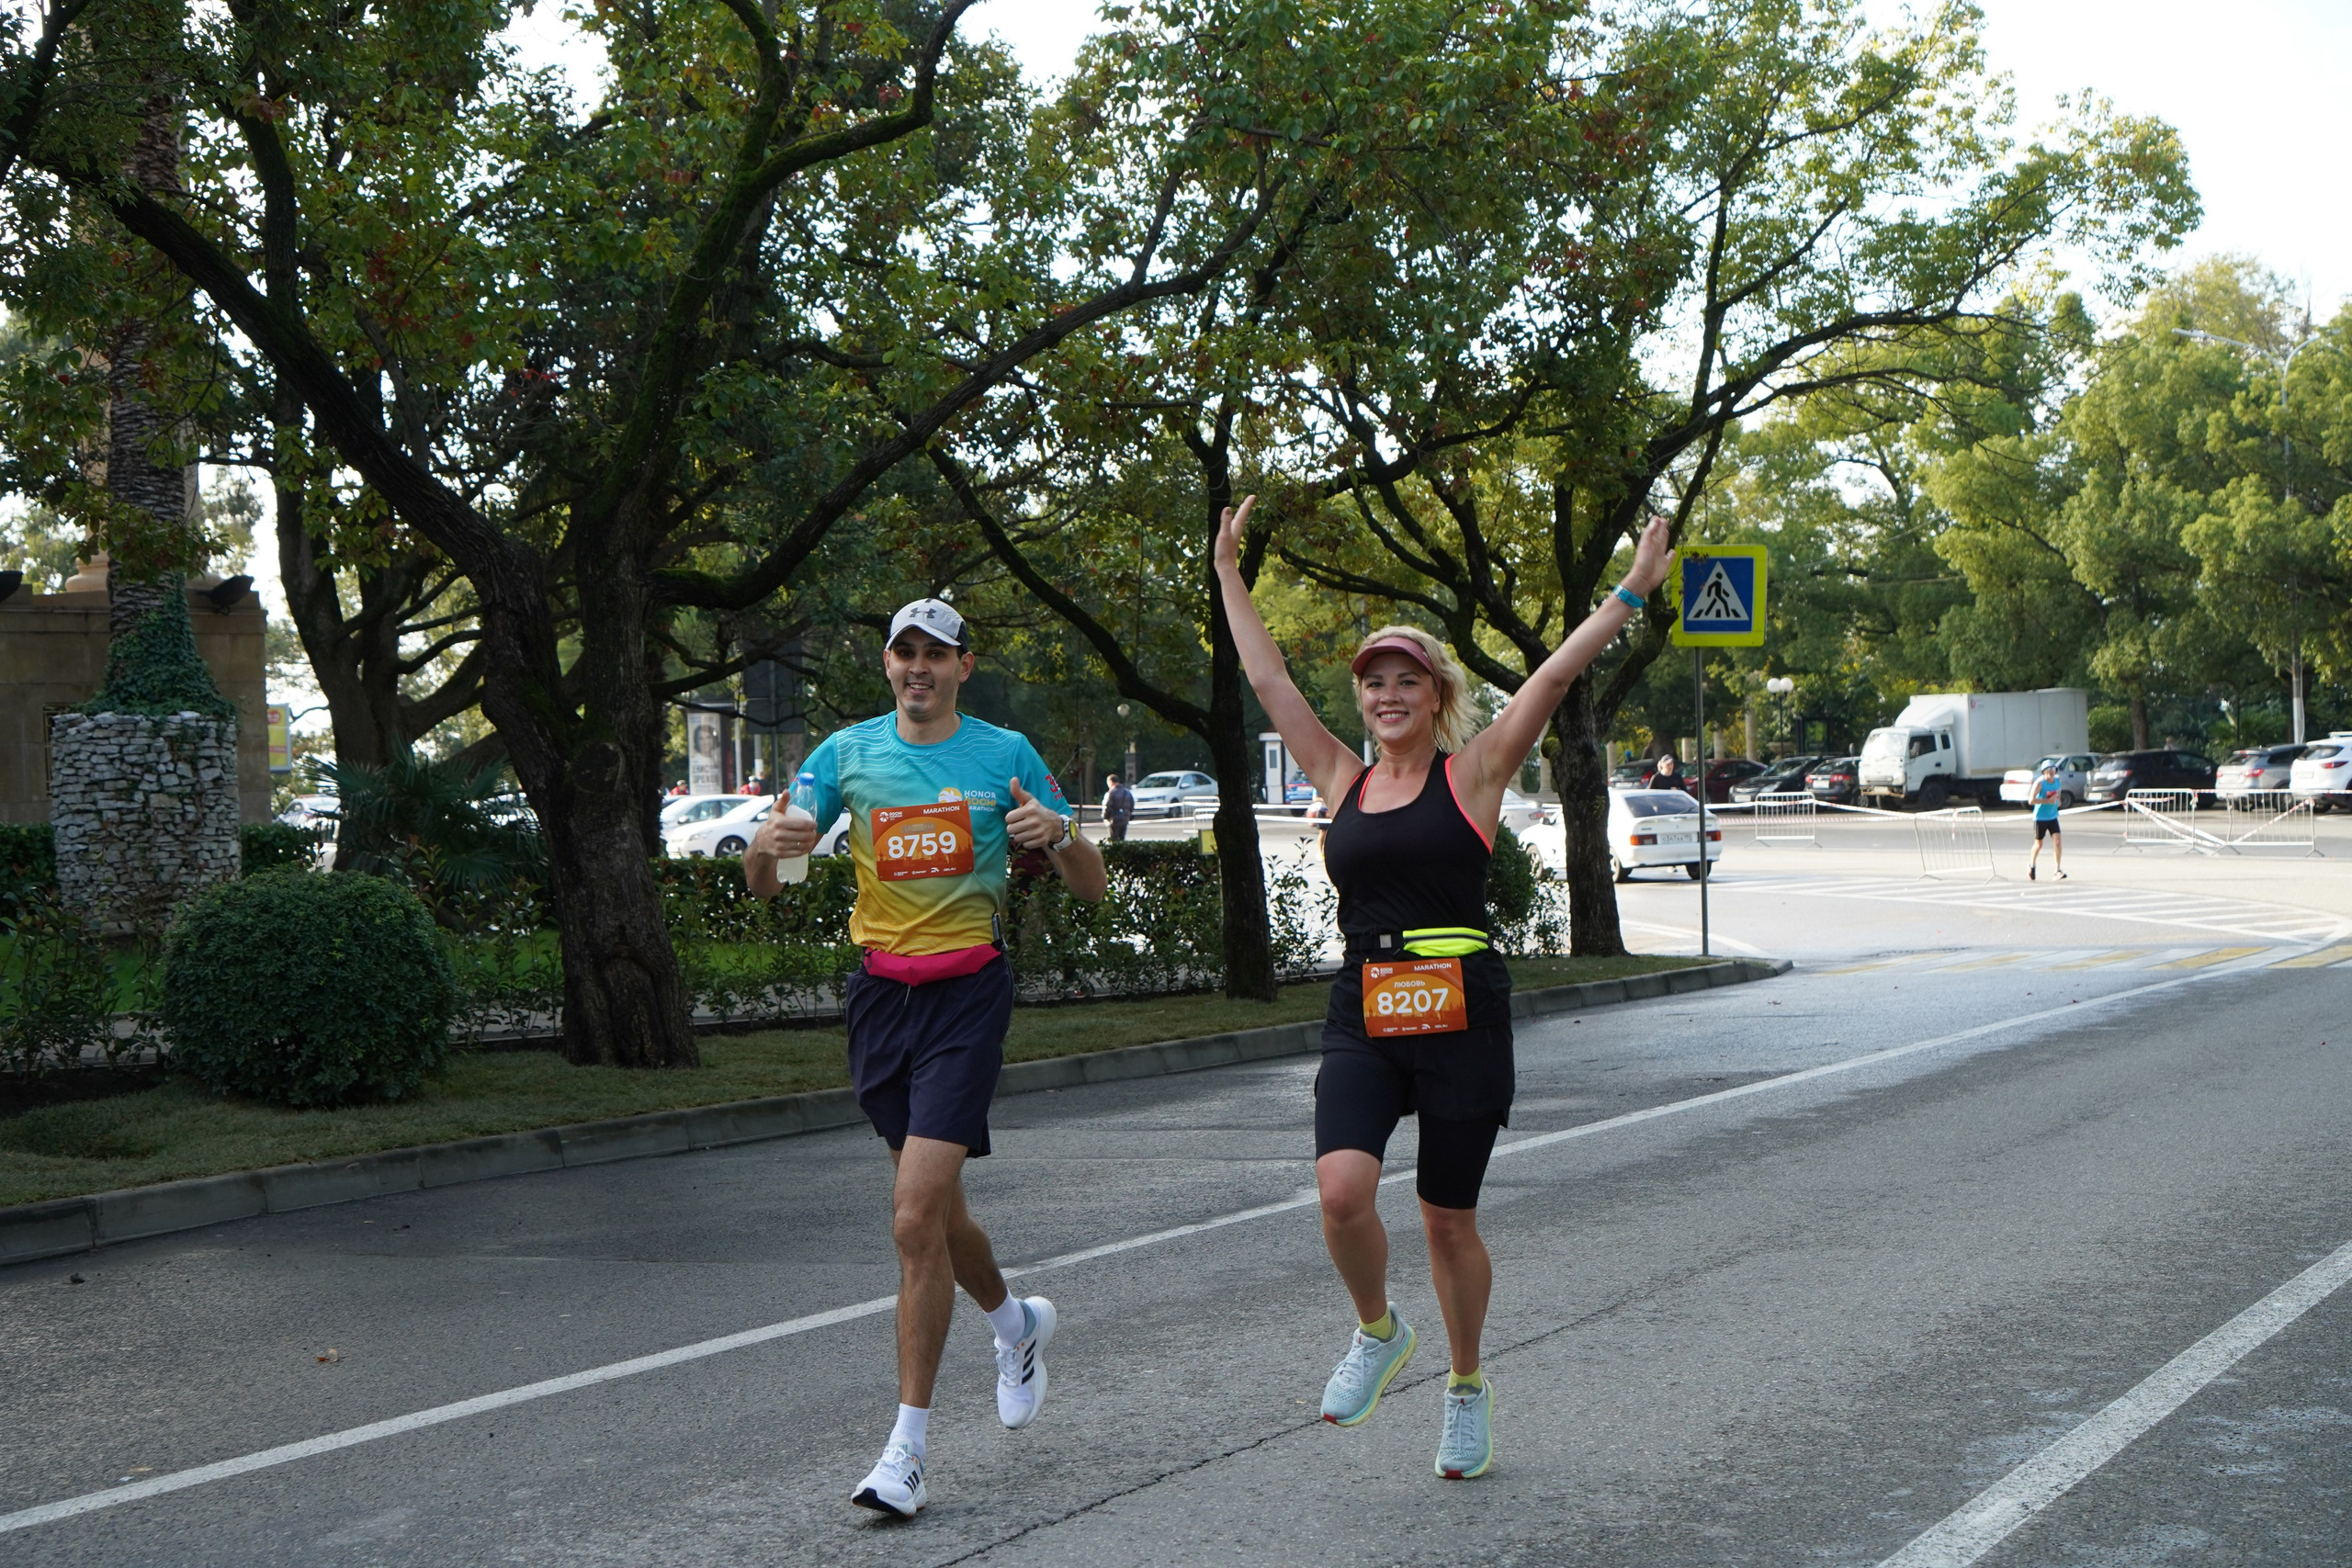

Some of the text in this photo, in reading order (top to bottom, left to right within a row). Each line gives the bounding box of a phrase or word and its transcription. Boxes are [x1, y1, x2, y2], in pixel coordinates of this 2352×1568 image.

[964, 790, 997, 799] HONOR
[923, 806, 960, 814] MARATHON
[888, 831, 956, 859] 8759
[1414, 963, 1452, 971] MARATHON
[1394, 979, 1426, 988] ЛЮБОВЬ
[1377, 987, 1449, 1015] 8207
